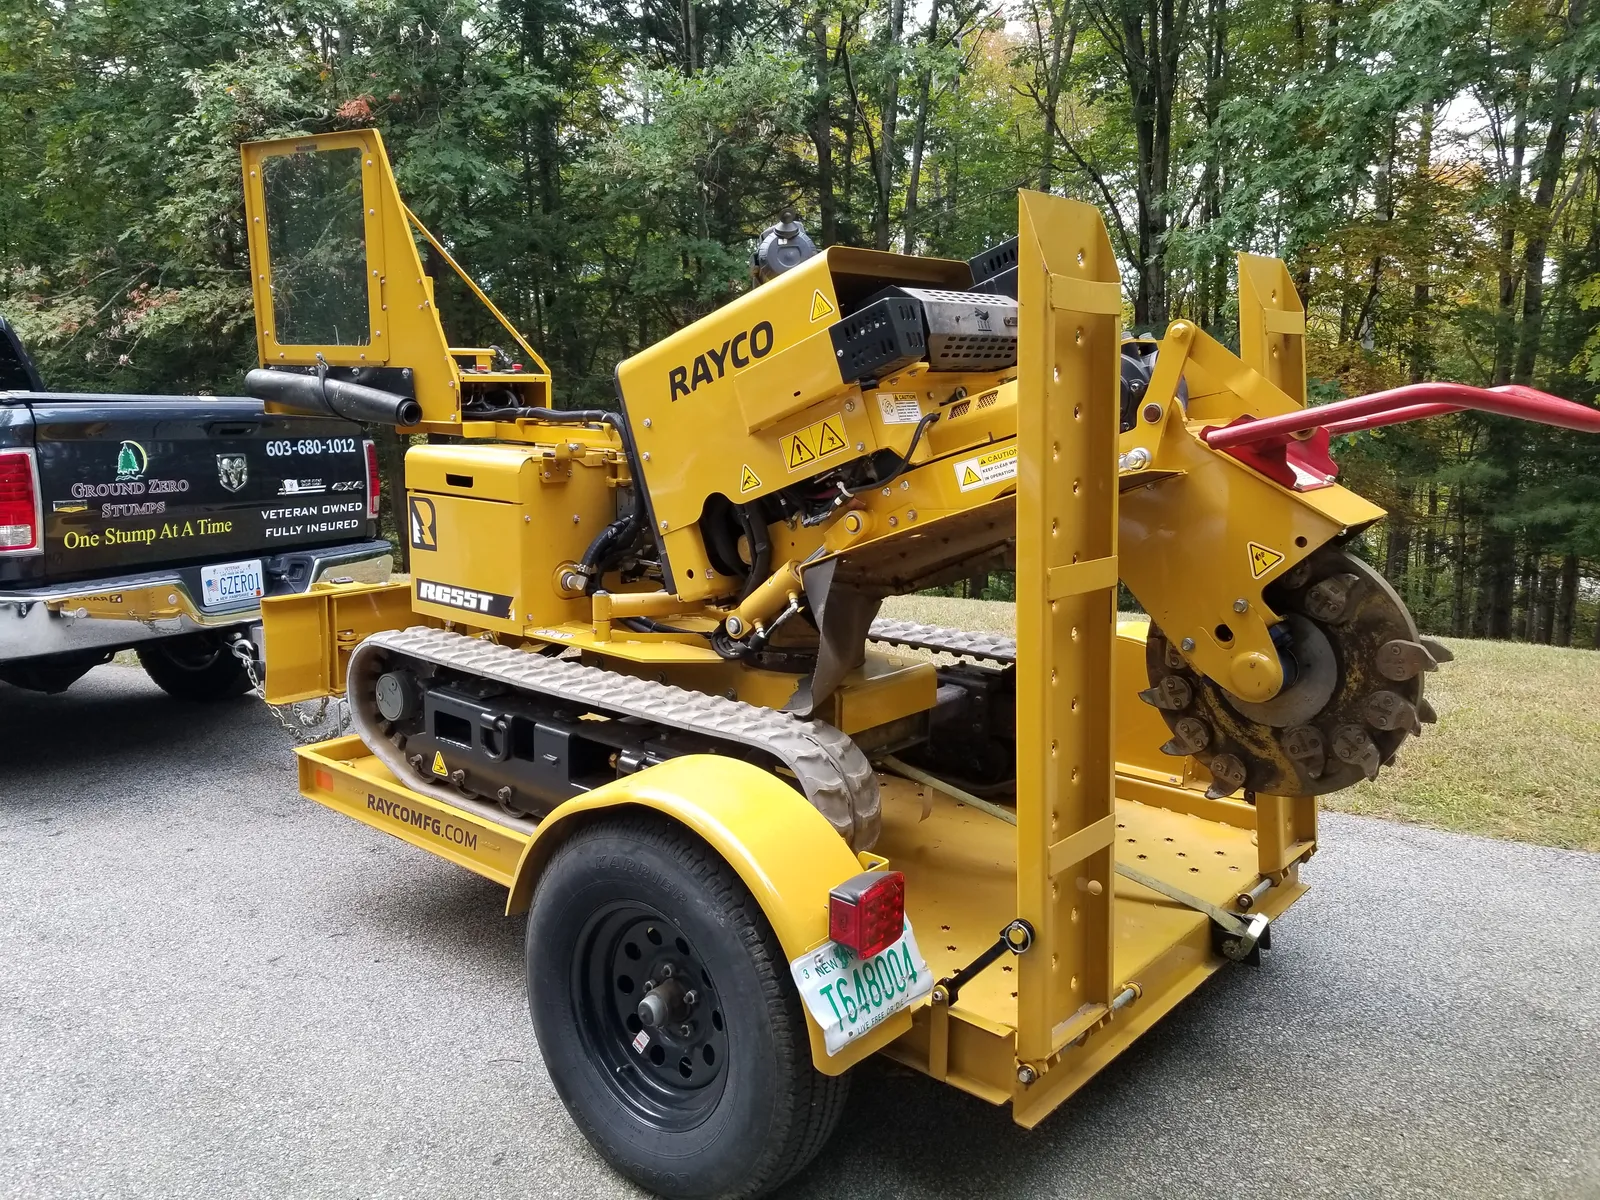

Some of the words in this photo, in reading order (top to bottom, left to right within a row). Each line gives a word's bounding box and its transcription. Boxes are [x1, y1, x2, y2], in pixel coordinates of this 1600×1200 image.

[669, 320, 774, 403] RAYCO
[266, 438, 356, 457] 603-680-1012
[990, 469, 1015, 480] OPERATION
[994, 462, 1009, 471] CLEAR
[71, 482, 145, 499] GROUND
[149, 479, 190, 494] ZERO
[101, 501, 166, 519] STUMPS
[261, 506, 318, 520] VETERAN
[322, 502, 363, 515] OWNED
[63, 531, 100, 549] One
[105, 527, 156, 546] Stump
[159, 523, 178, 540] At
[181, 521, 194, 537] A
[197, 518, 232, 536] Time
[265, 524, 303, 538] FULLY
[307, 519, 359, 533] INSURED
[420, 581, 493, 612] RG55T
[367, 793, 477, 851] RAYCOMFG.COM
[595, 854, 687, 904] KARRIER
[802, 968, 810, 980] 3
[814, 959, 839, 978] NEW
[819, 940, 918, 1032] T648004
[857, 1021, 870, 1034] LIVE
[871, 1011, 885, 1025] FREE
